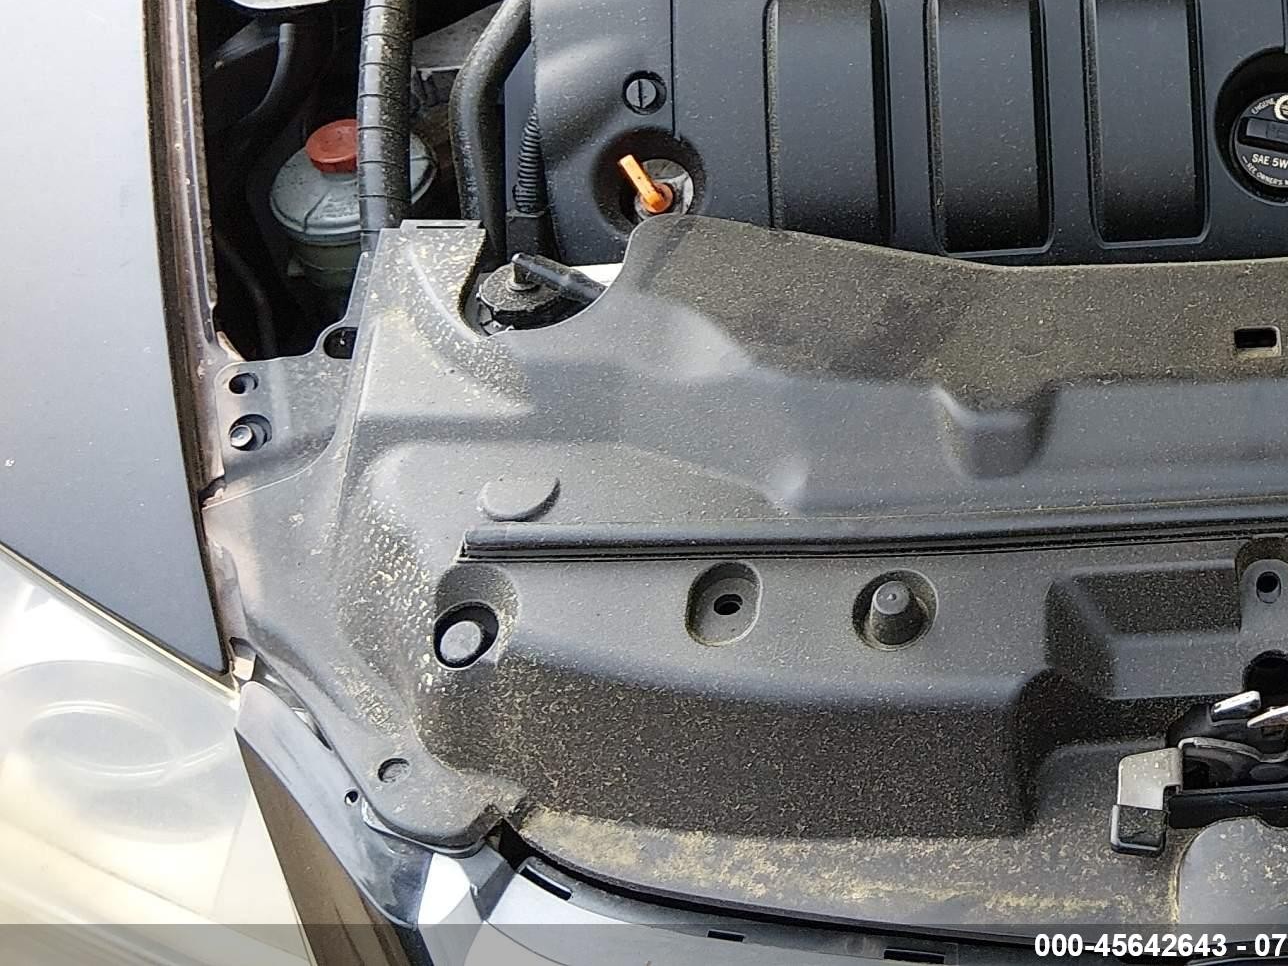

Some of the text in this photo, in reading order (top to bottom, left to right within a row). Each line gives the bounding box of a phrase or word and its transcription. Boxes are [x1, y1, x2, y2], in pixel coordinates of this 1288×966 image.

[1251, 97, 1275, 114] ENGINE
[1252, 153, 1270, 166] SAE
[1246, 163, 1258, 175] SEE
